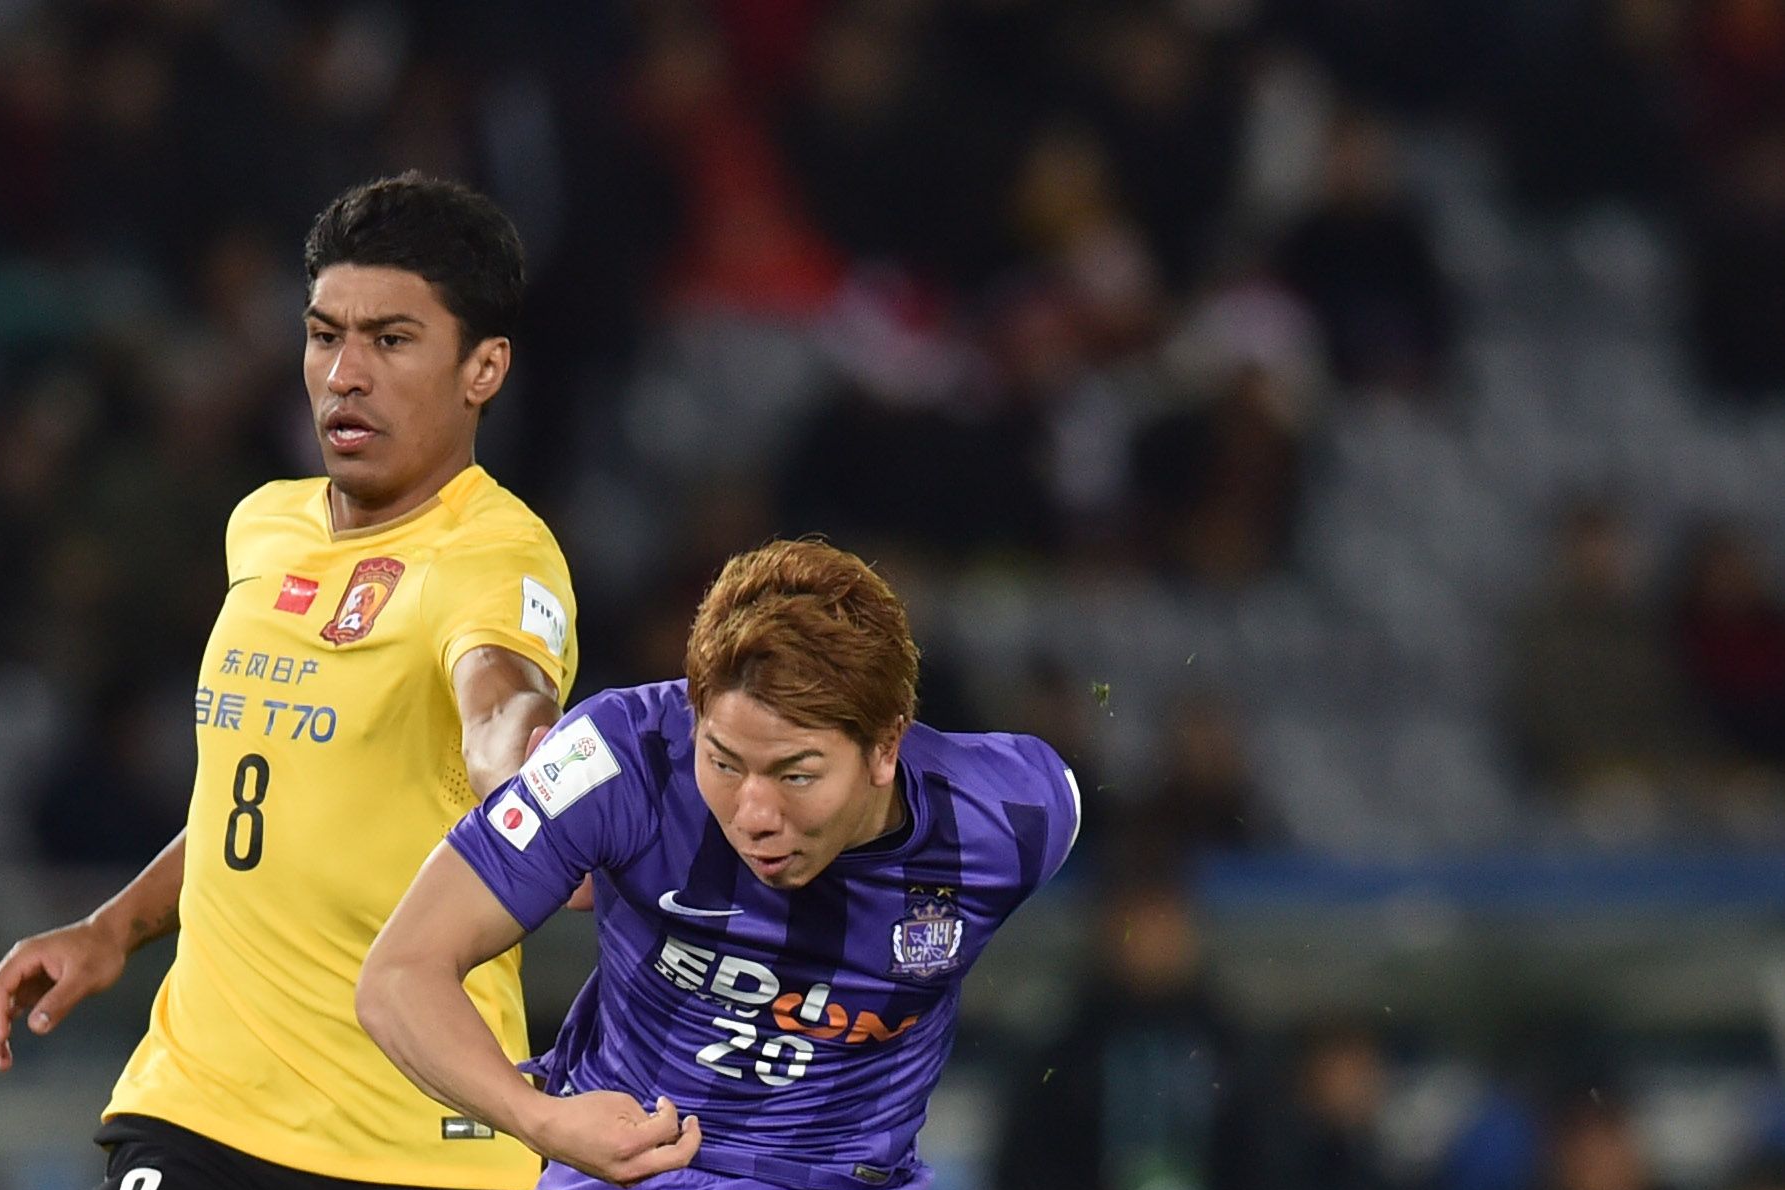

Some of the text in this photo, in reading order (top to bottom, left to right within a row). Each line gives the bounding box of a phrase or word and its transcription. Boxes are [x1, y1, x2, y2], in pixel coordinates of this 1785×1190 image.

[220, 649, 319, 685] 东风日产
[263, 699, 337, 743] T70
[224, 753, 270, 872] 8
